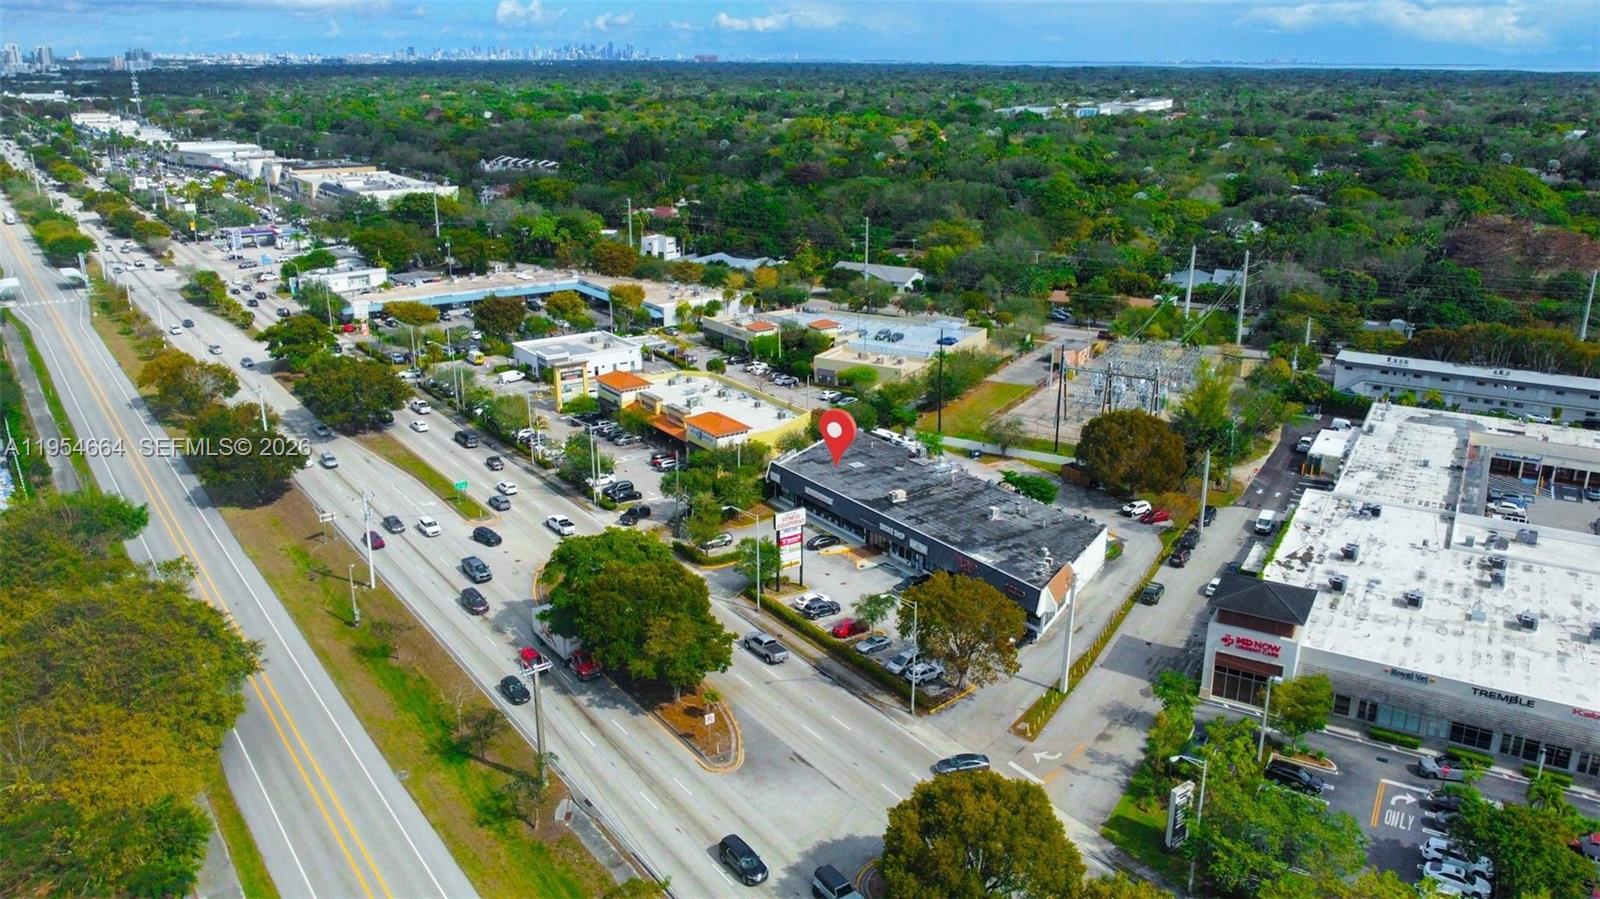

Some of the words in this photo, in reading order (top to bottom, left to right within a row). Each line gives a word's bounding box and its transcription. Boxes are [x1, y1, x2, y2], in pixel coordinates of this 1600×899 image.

[1235, 645, 1261, 653] URGENT
[1262, 650, 1279, 658] CARE
[1254, 641, 1281, 652] NOW
[1390, 668, 1414, 680] Royal
[1471, 687, 1536, 708] TREMBLE
[1384, 809, 1415, 832] ONLY
